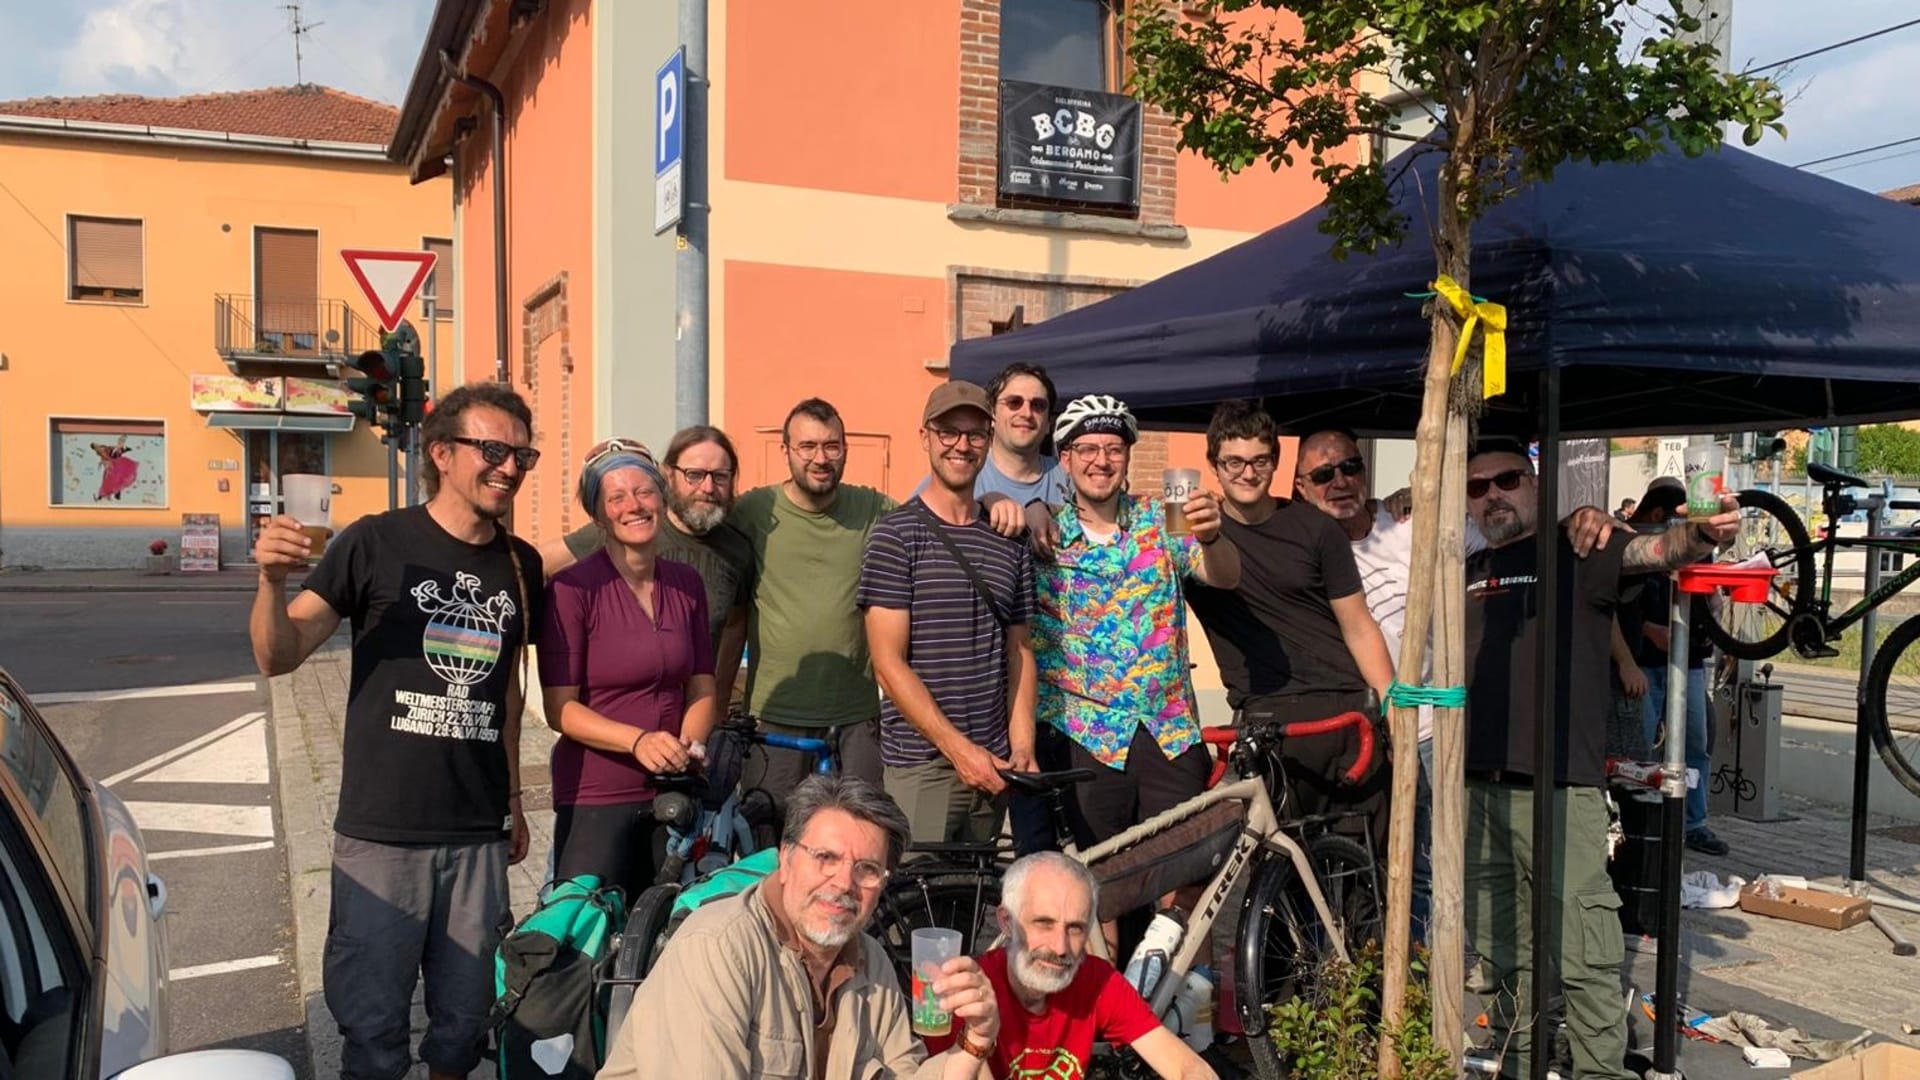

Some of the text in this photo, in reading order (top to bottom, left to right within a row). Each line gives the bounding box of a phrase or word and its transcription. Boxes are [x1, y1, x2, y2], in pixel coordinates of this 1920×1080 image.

[660, 70, 677, 162] P
[1031, 108, 1115, 149] BCBG
[1045, 144, 1100, 160] BERGAMO
[1664, 442, 1681, 451] TEB
[446, 684, 469, 699] RAD
[390, 716, 433, 735] LUGANO
[1201, 838, 1250, 920] TREK
